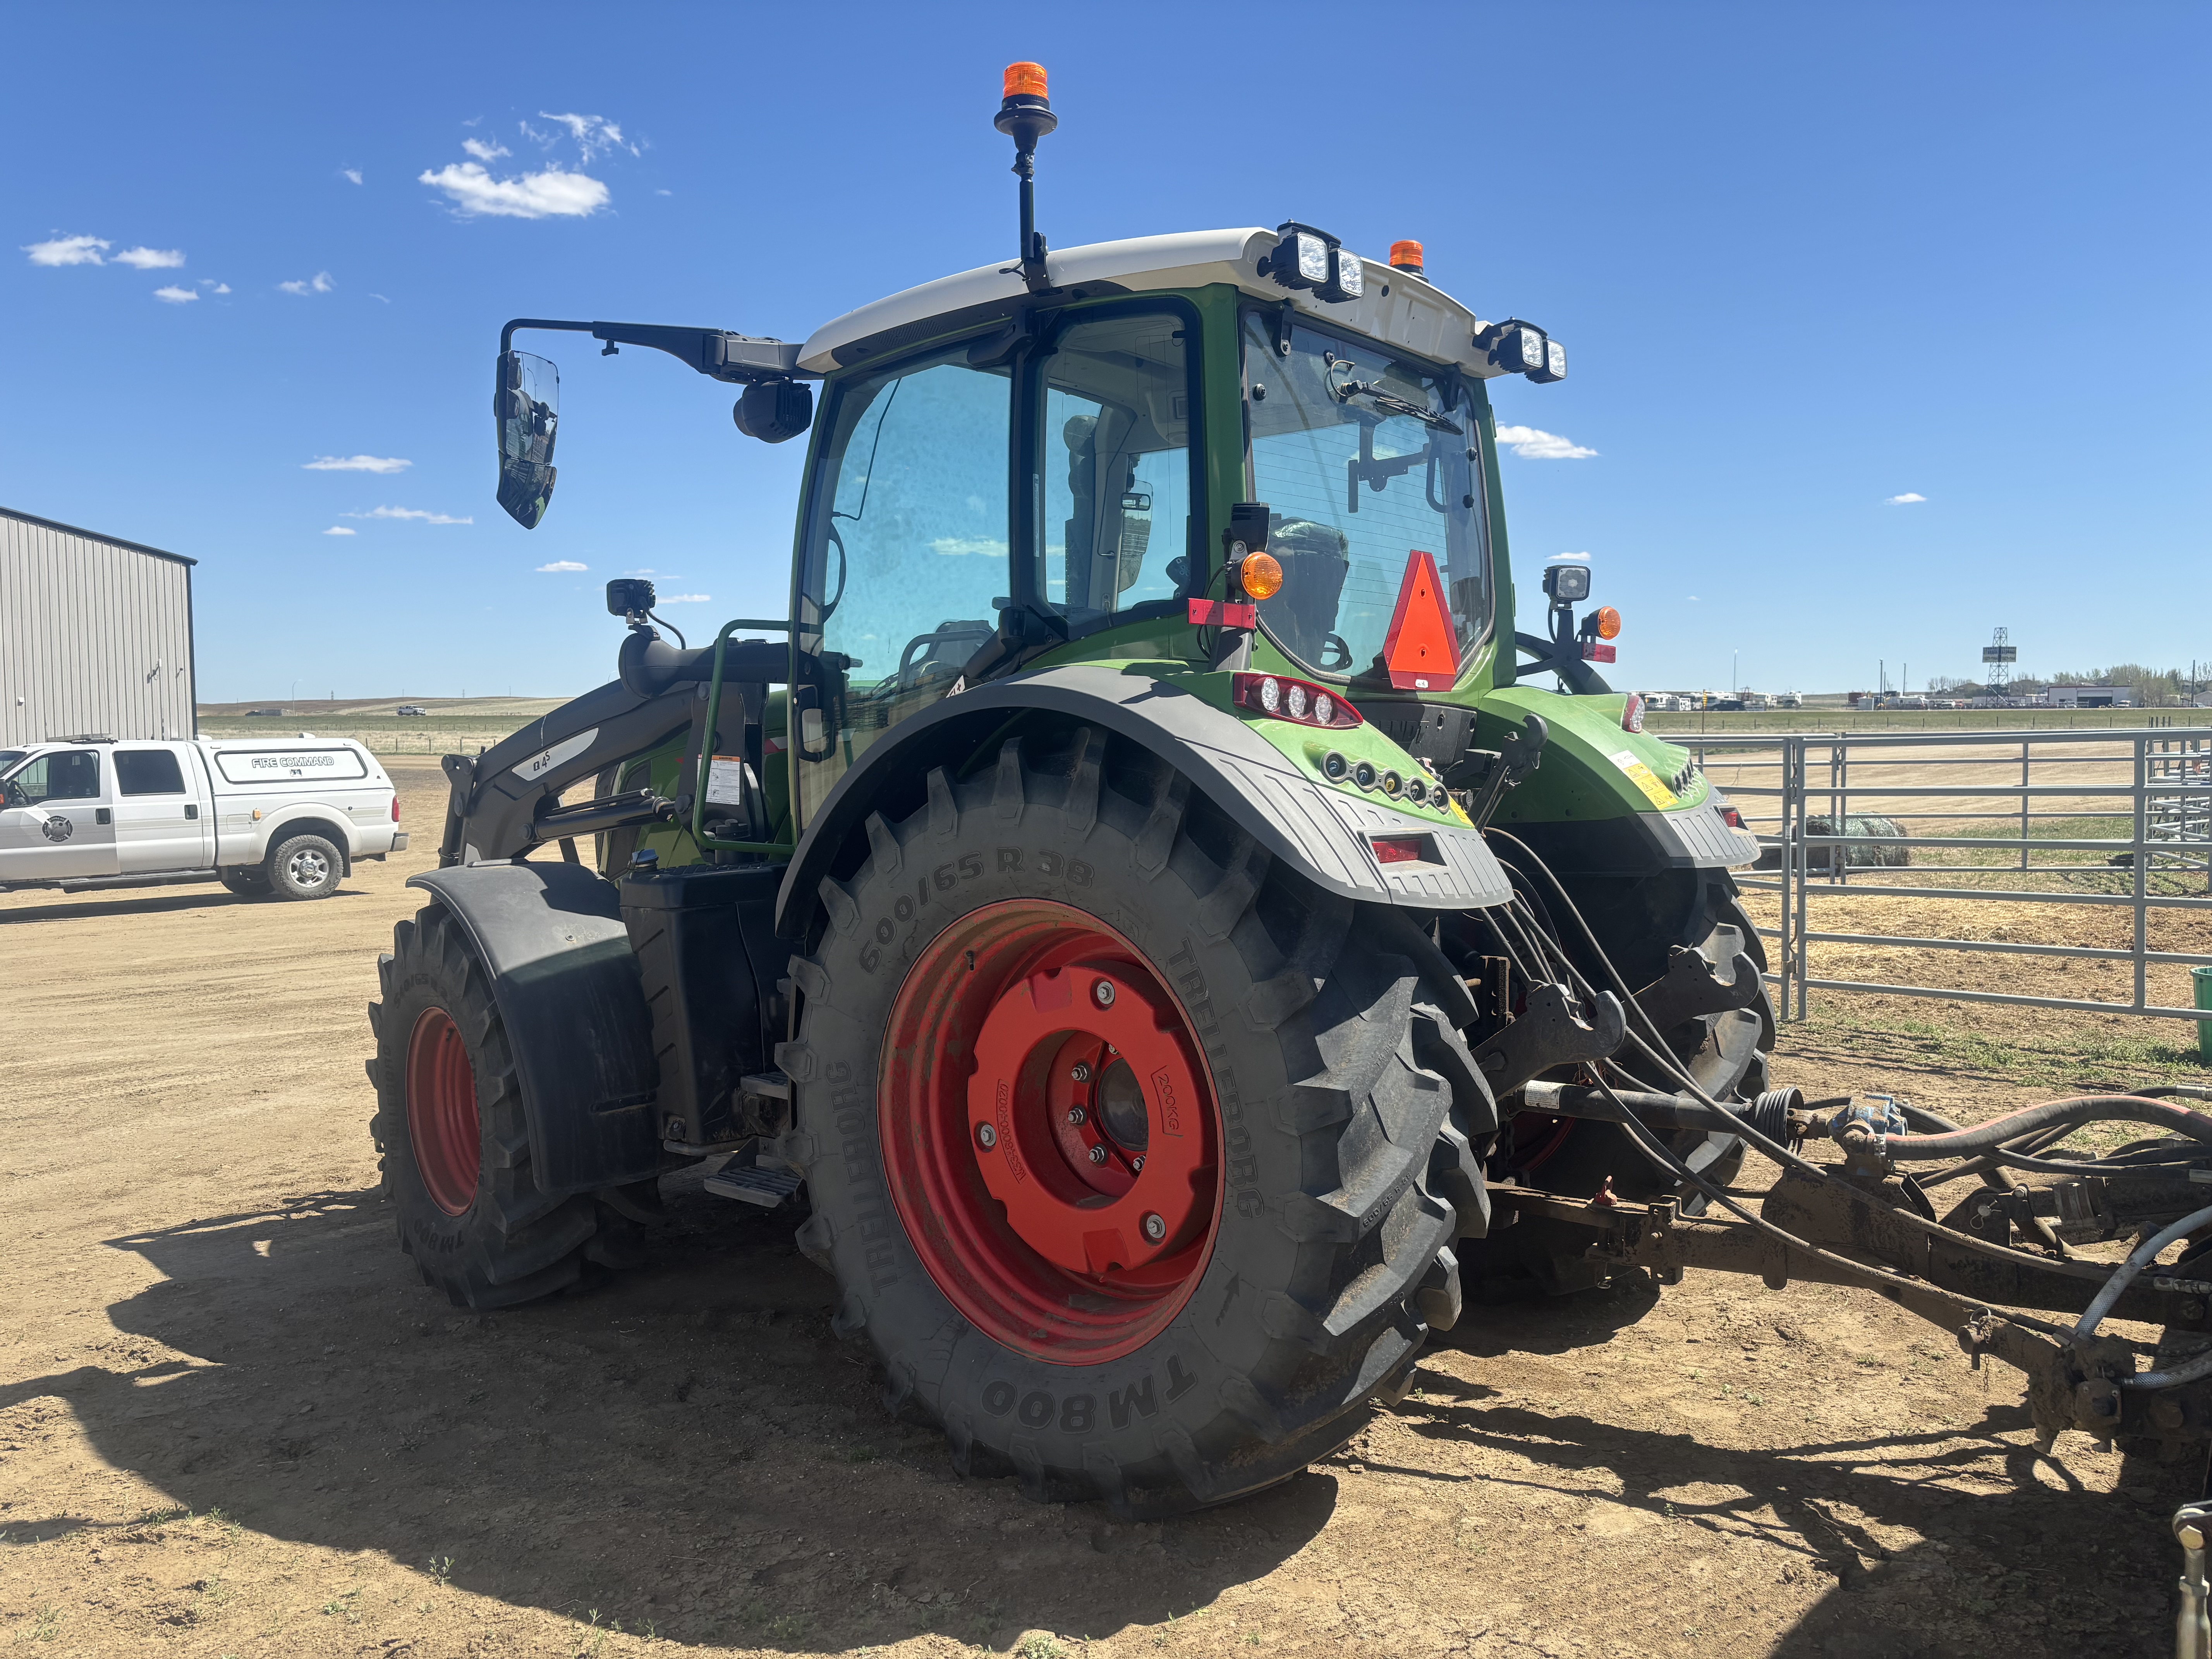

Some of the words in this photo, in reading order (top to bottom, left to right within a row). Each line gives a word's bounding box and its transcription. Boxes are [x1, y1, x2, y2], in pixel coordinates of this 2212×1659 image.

[252, 758, 278, 768] FIRE
[280, 756, 334, 767] COMMAND
[858, 850, 984, 974] 600/65
[996, 846, 1024, 874] R
[1038, 849, 1095, 889] 38
[1157, 1073, 1180, 1130] 200KG
[1168, 938, 1264, 1219] TRELLEBORG
[824, 1060, 898, 1298] TRELLEBORG
